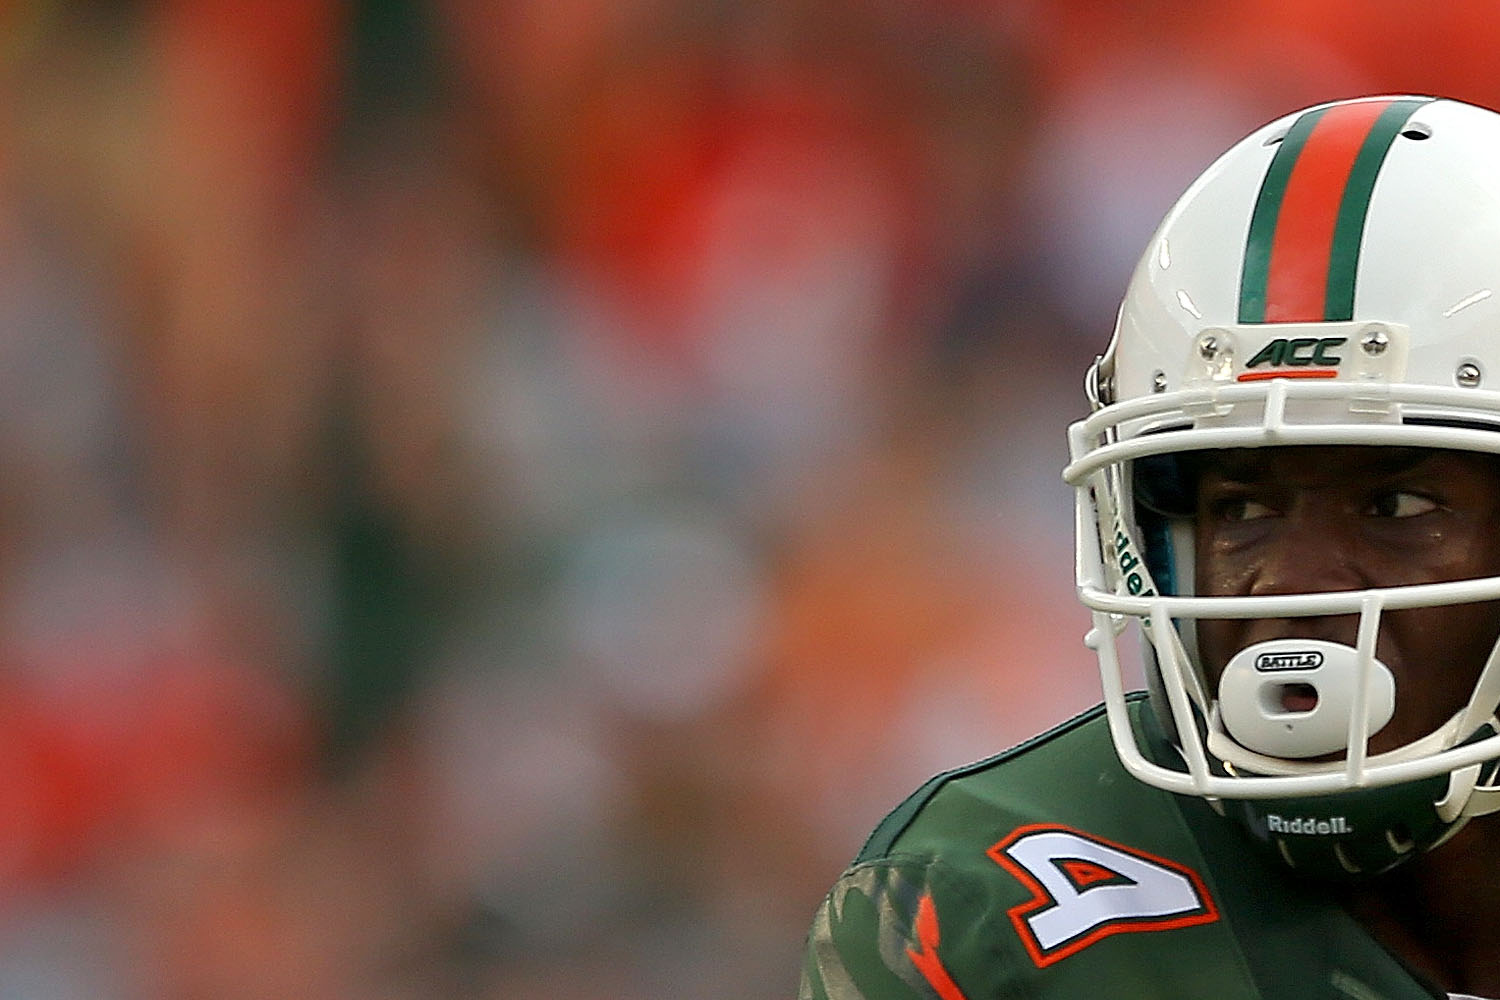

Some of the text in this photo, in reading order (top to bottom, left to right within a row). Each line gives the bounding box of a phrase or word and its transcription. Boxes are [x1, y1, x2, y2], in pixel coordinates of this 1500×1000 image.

[1245, 337, 1348, 368] ACC
[1261, 654, 1317, 668] BATTLE
[985, 822, 1221, 969] 4
